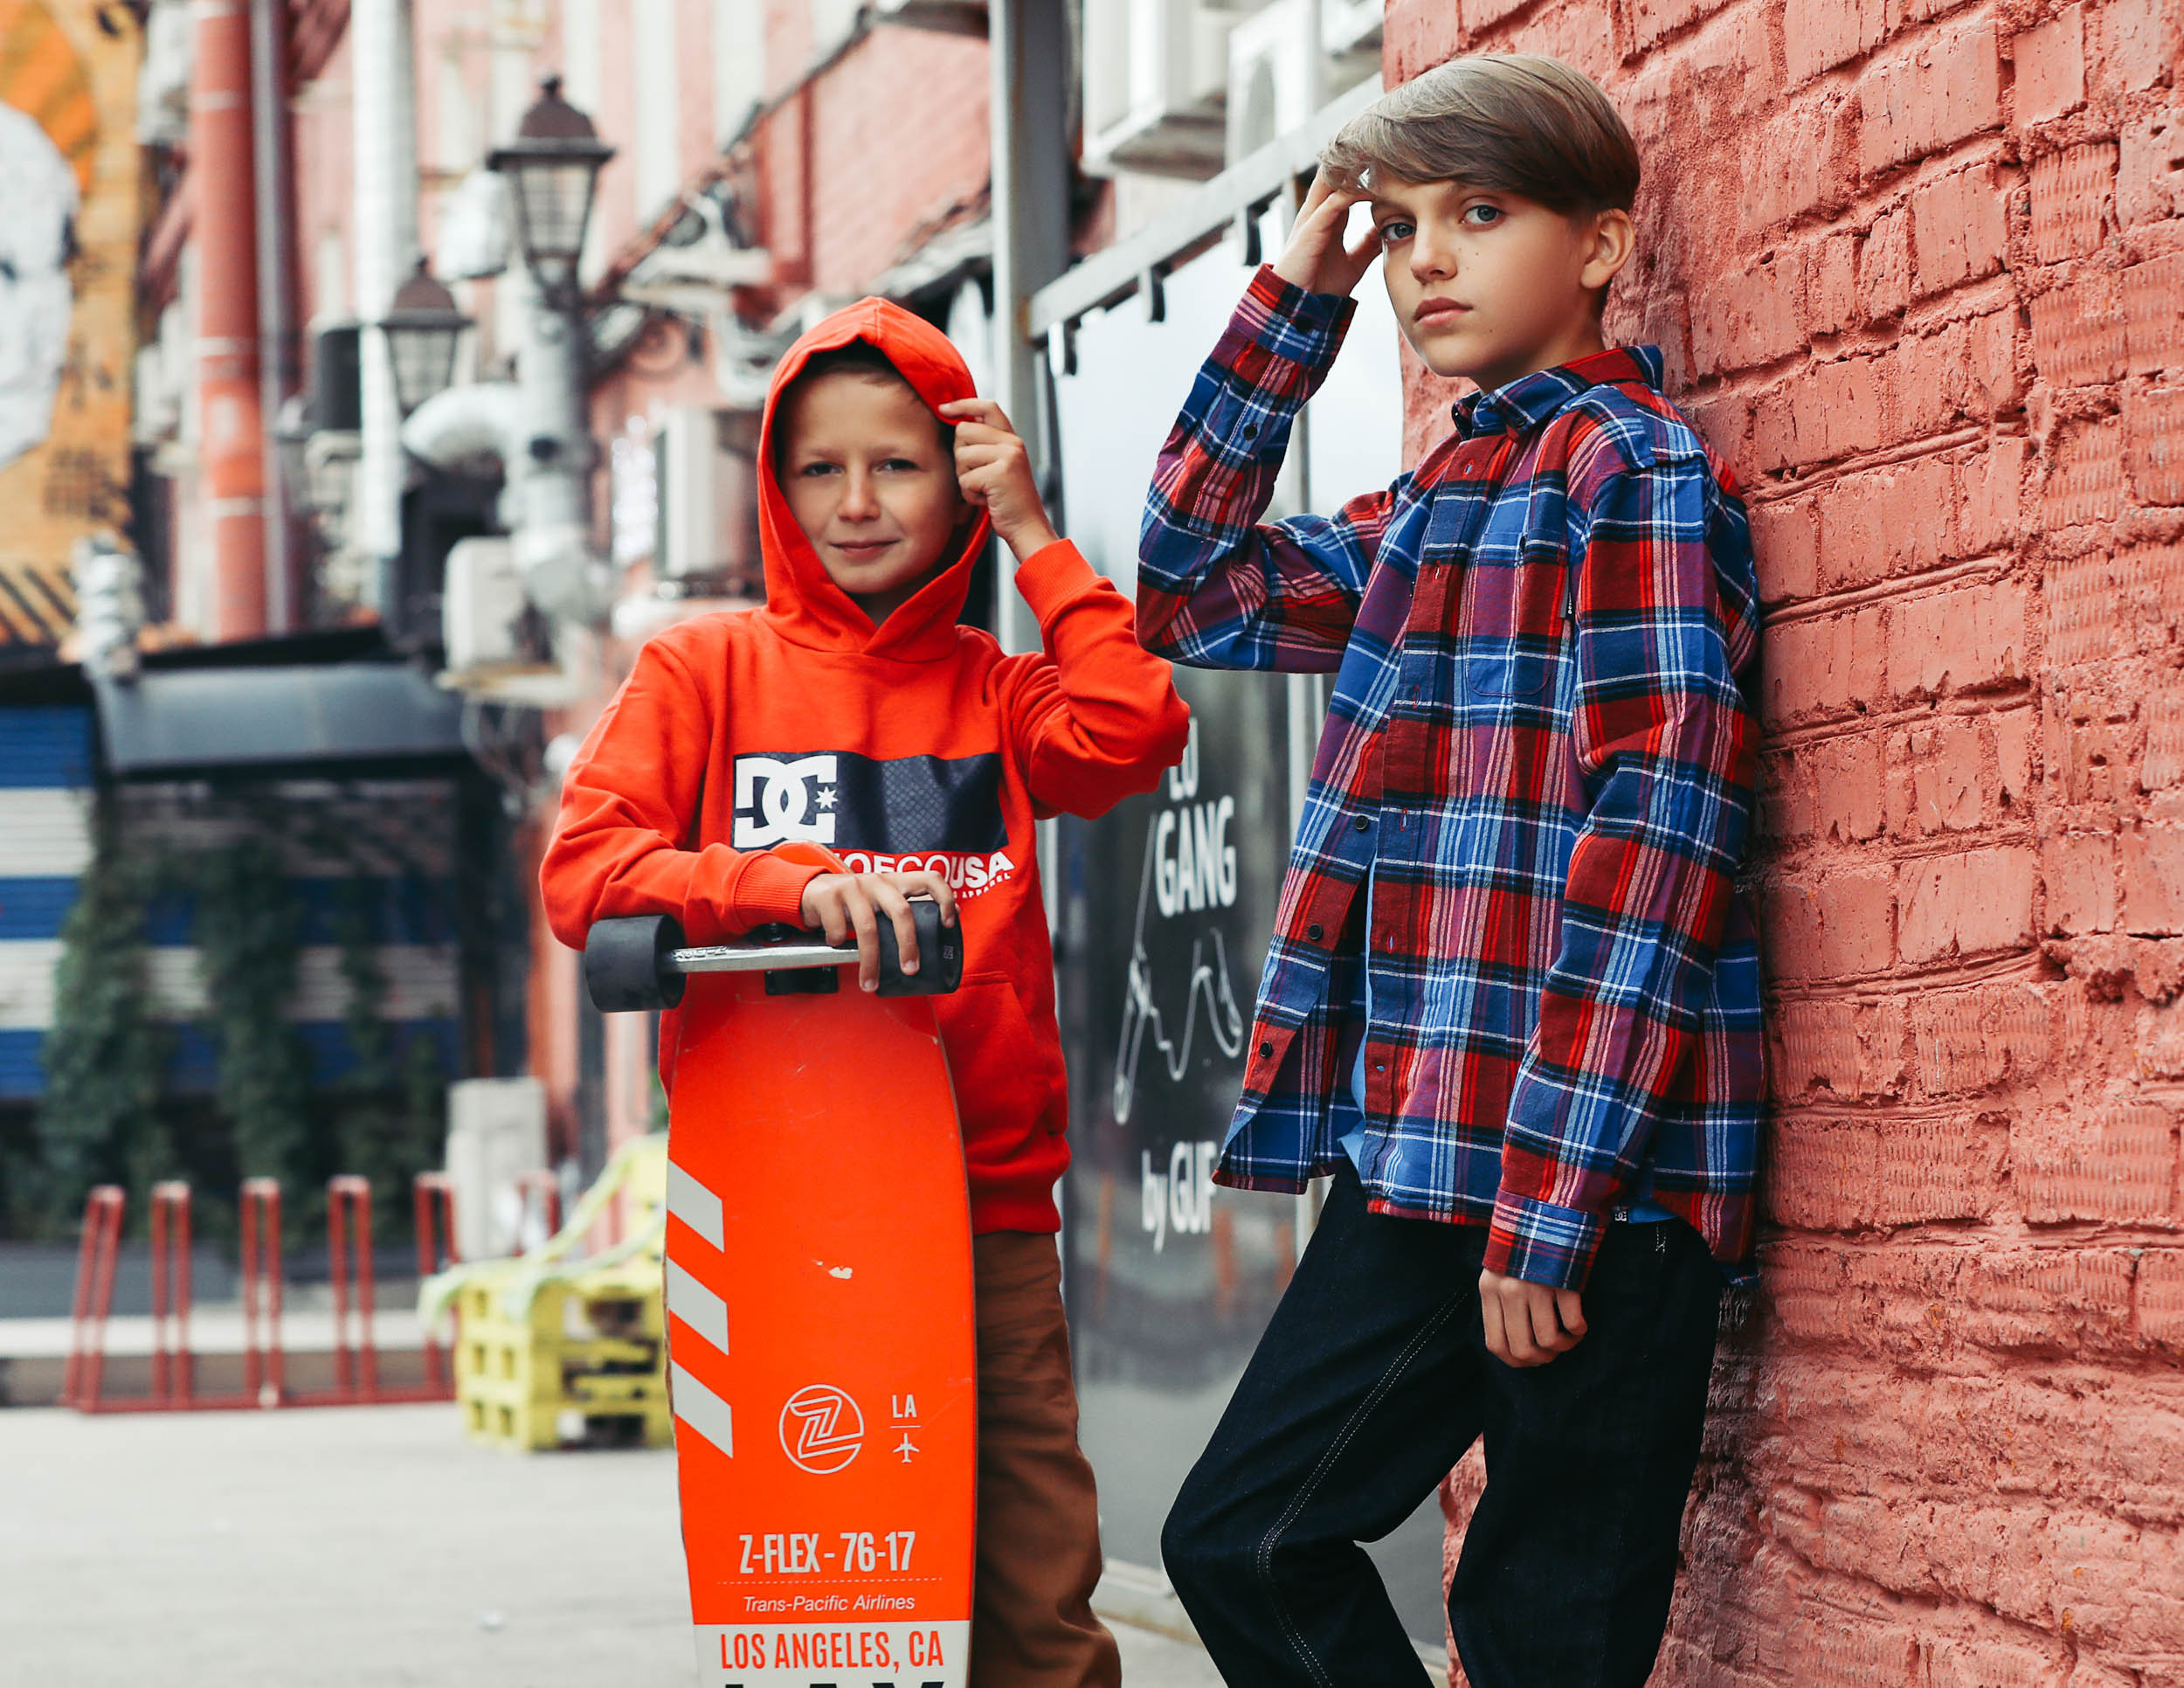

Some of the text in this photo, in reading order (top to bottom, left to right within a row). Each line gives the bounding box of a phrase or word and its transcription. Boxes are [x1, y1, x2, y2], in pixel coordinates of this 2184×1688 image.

[1156, 794, 1237, 918] GANG
[1141, 1139, 1218, 1255] by GUF
[891, 1394, 917, 1418] LA
[738, 1532, 821, 1574] Z-FLEX
[839, 1530, 916, 1573] 76-17
[743, 1594, 916, 1613] Trans-Pacific Airlines
[720, 1629, 944, 1674] LOS ANGELES, CA
